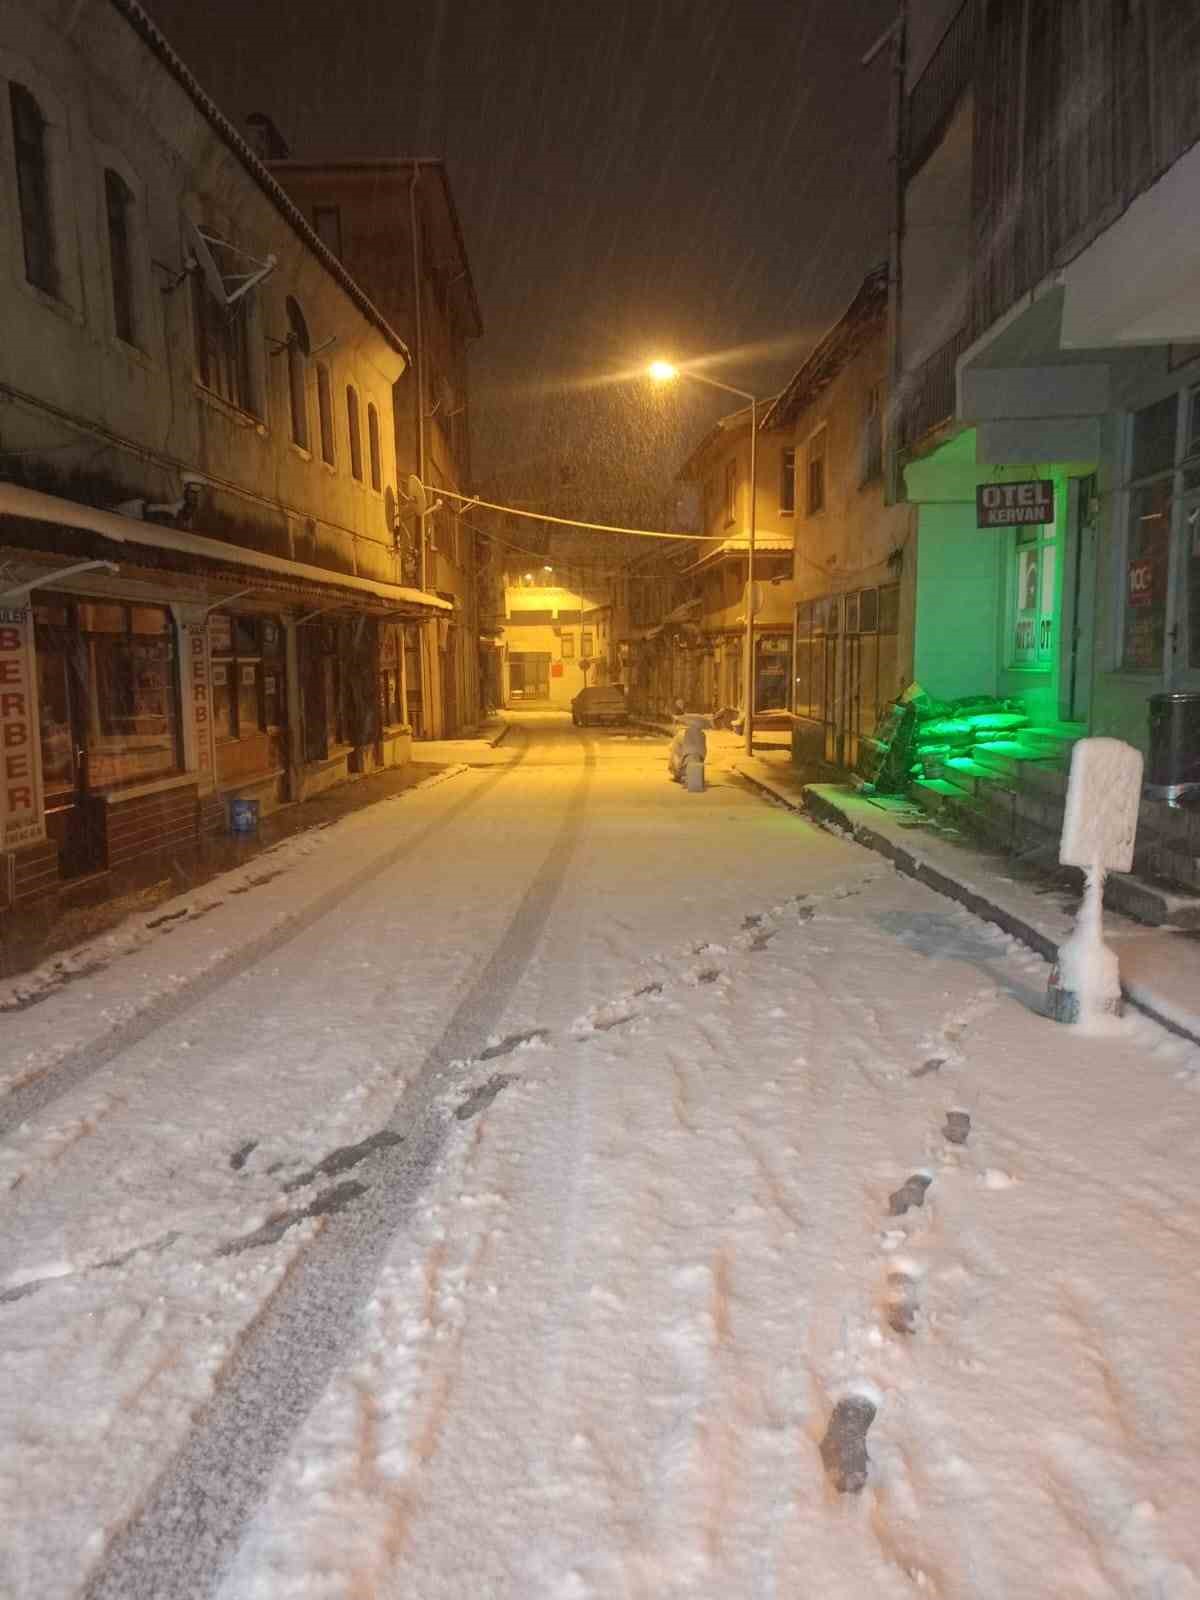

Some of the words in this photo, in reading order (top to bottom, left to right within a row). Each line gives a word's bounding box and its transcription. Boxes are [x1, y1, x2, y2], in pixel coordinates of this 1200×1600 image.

[982, 483, 1050, 508] OTEL
[987, 506, 1045, 523] KERVAN
[0, 627, 31, 812] BERBER
[192, 637, 209, 770] BERBER
